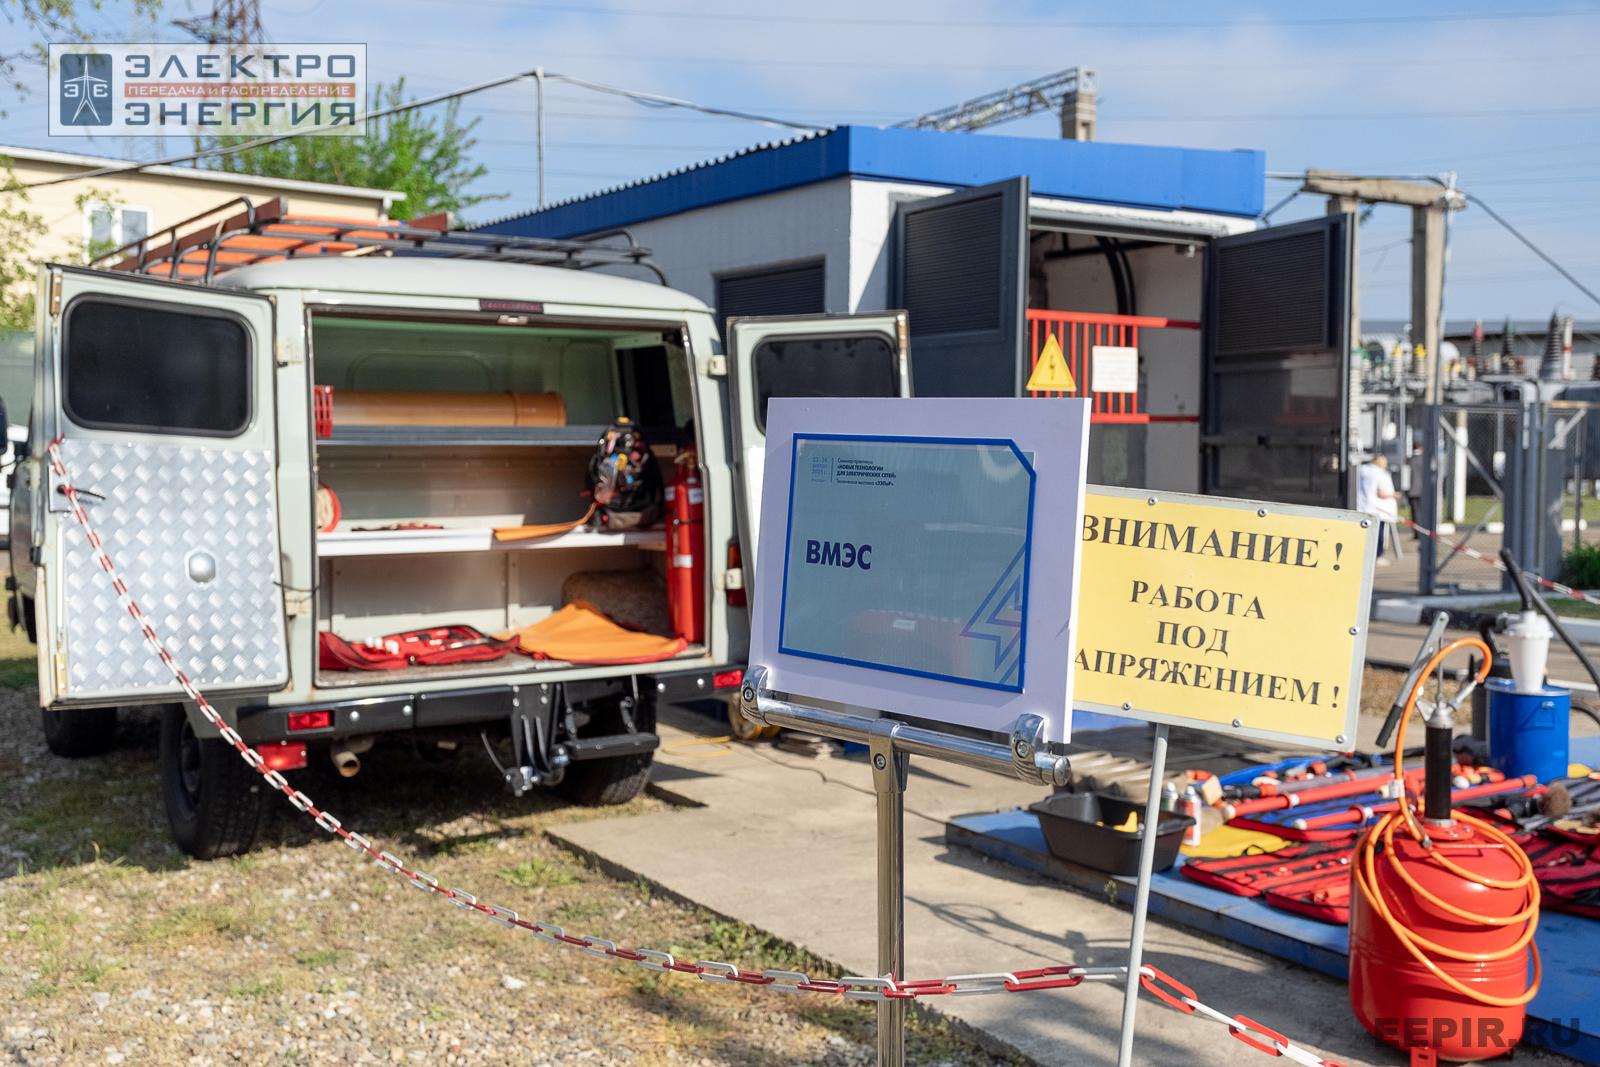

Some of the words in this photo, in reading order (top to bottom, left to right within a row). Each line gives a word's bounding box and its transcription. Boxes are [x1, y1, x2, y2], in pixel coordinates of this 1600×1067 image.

[806, 539, 872, 571] ВМЭС
[1082, 515, 1319, 569] ВНИМАНИЕ
[1130, 580, 1266, 620] РАБОТА
[1156, 621, 1230, 657] ПОД
[1074, 648, 1321, 706] АПРЯЖЕНИЕМ
